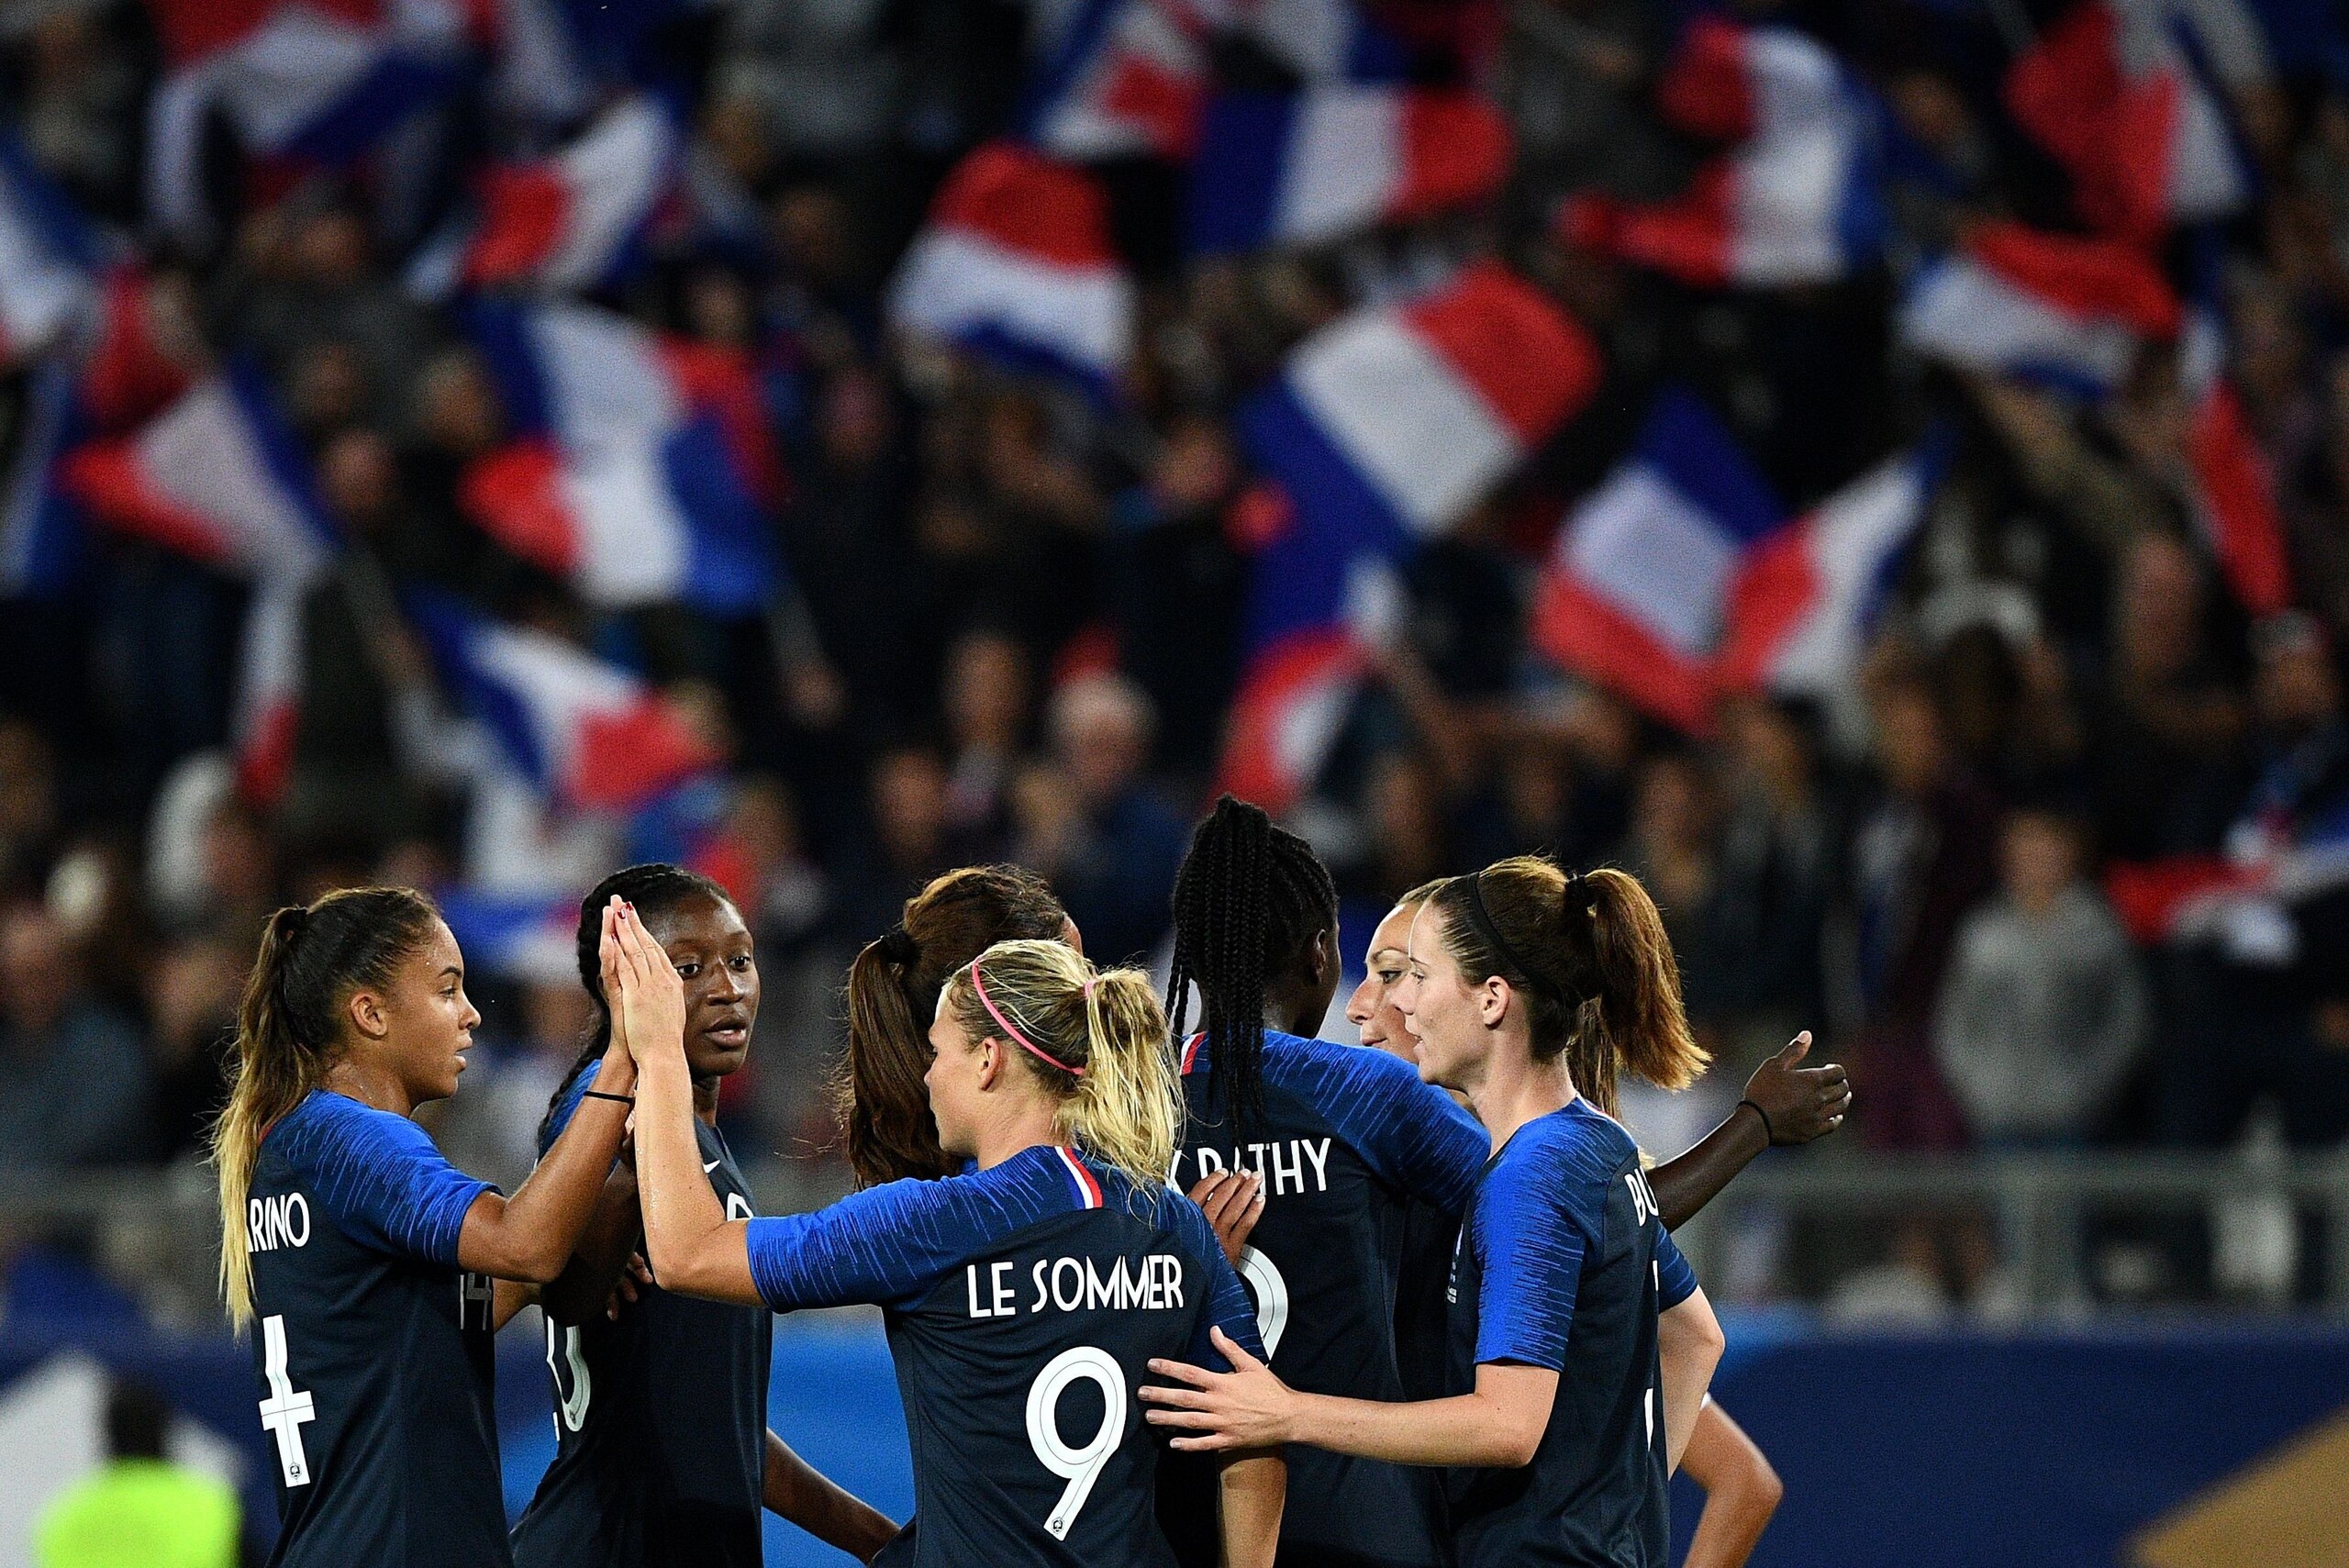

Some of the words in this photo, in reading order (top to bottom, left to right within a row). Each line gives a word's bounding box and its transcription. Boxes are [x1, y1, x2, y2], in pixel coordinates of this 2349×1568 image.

[967, 1262, 1016, 1318] LE
[1031, 1254, 1184, 1313] SOMMER
[1025, 1346, 1127, 1541] 9
